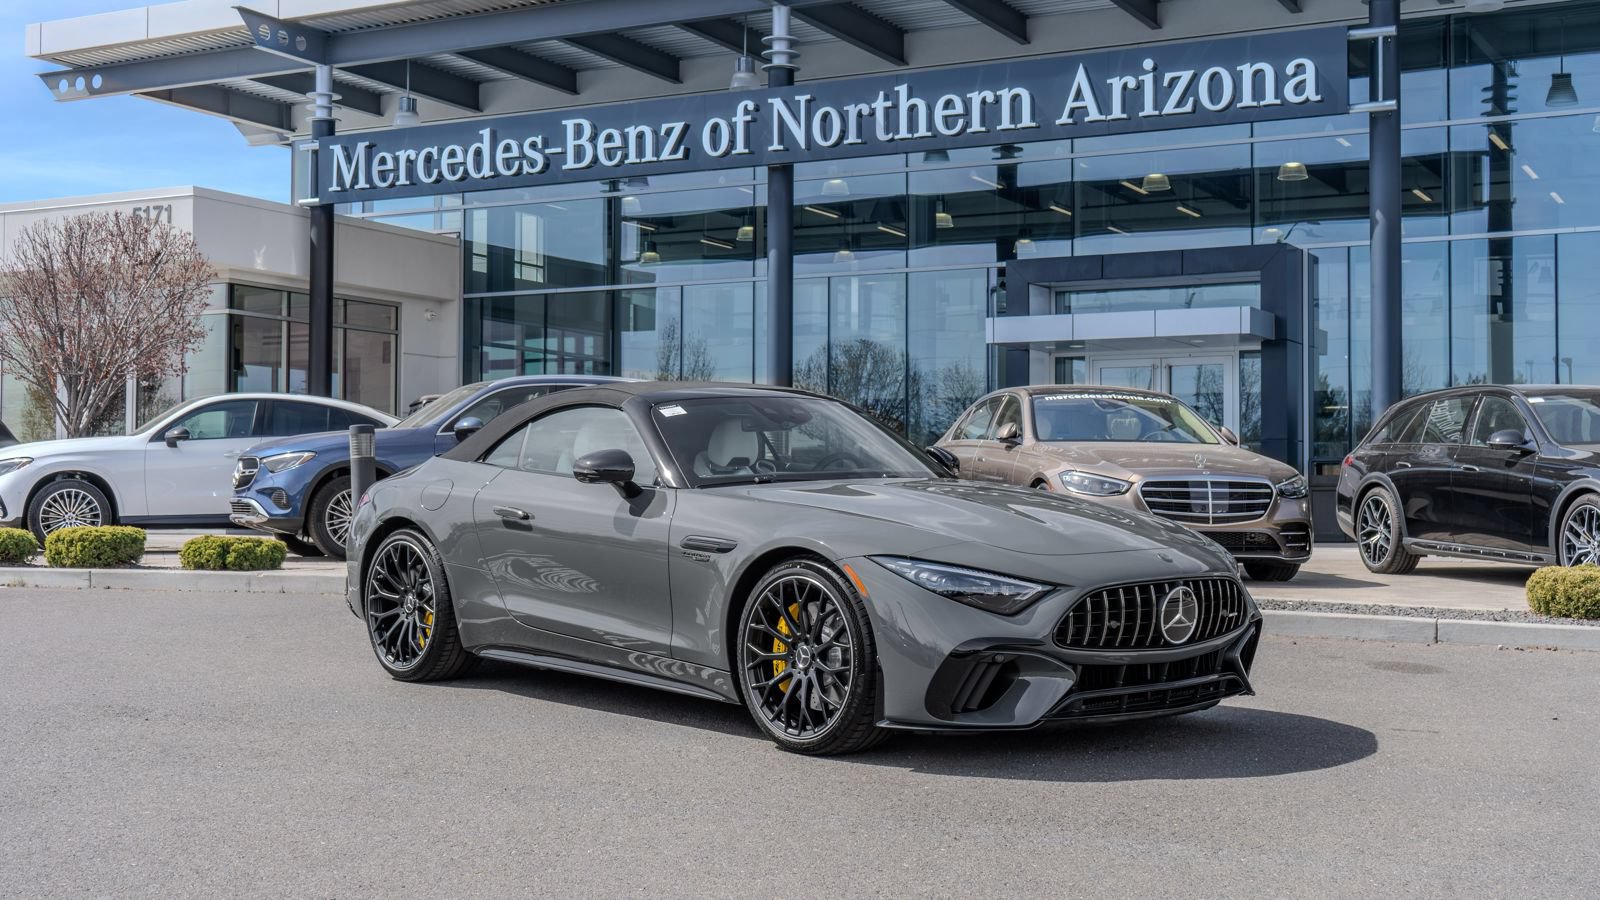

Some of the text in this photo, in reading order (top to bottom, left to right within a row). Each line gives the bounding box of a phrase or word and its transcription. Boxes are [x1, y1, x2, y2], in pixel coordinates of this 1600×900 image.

[328, 57, 1321, 192] Mercedes-Benz of Northern Arizona
[133, 204, 172, 226] 5171
